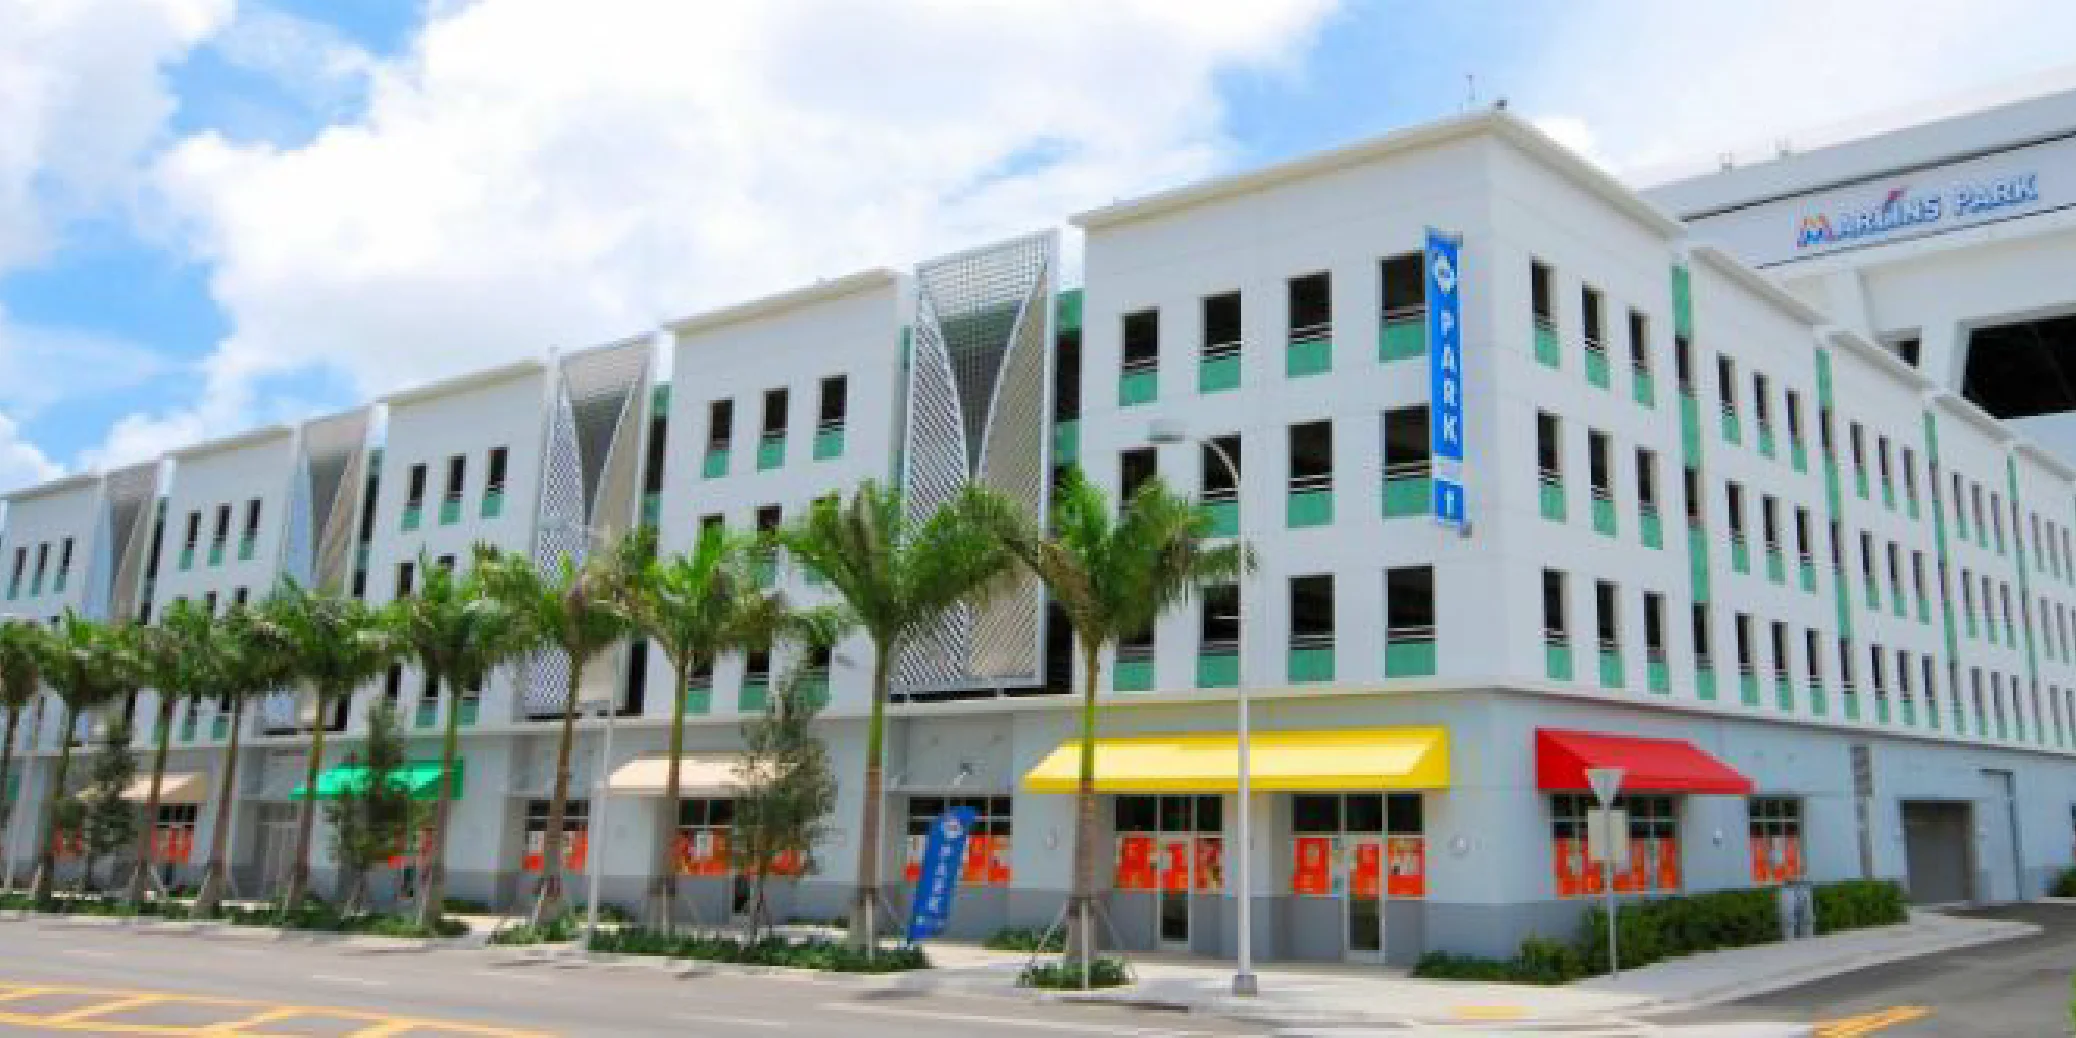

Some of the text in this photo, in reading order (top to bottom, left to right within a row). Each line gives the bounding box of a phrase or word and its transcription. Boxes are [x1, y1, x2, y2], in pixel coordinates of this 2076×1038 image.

[1953, 173, 2038, 217] PARK
[1439, 310, 1458, 445] PARK
[928, 843, 951, 914] PARK
